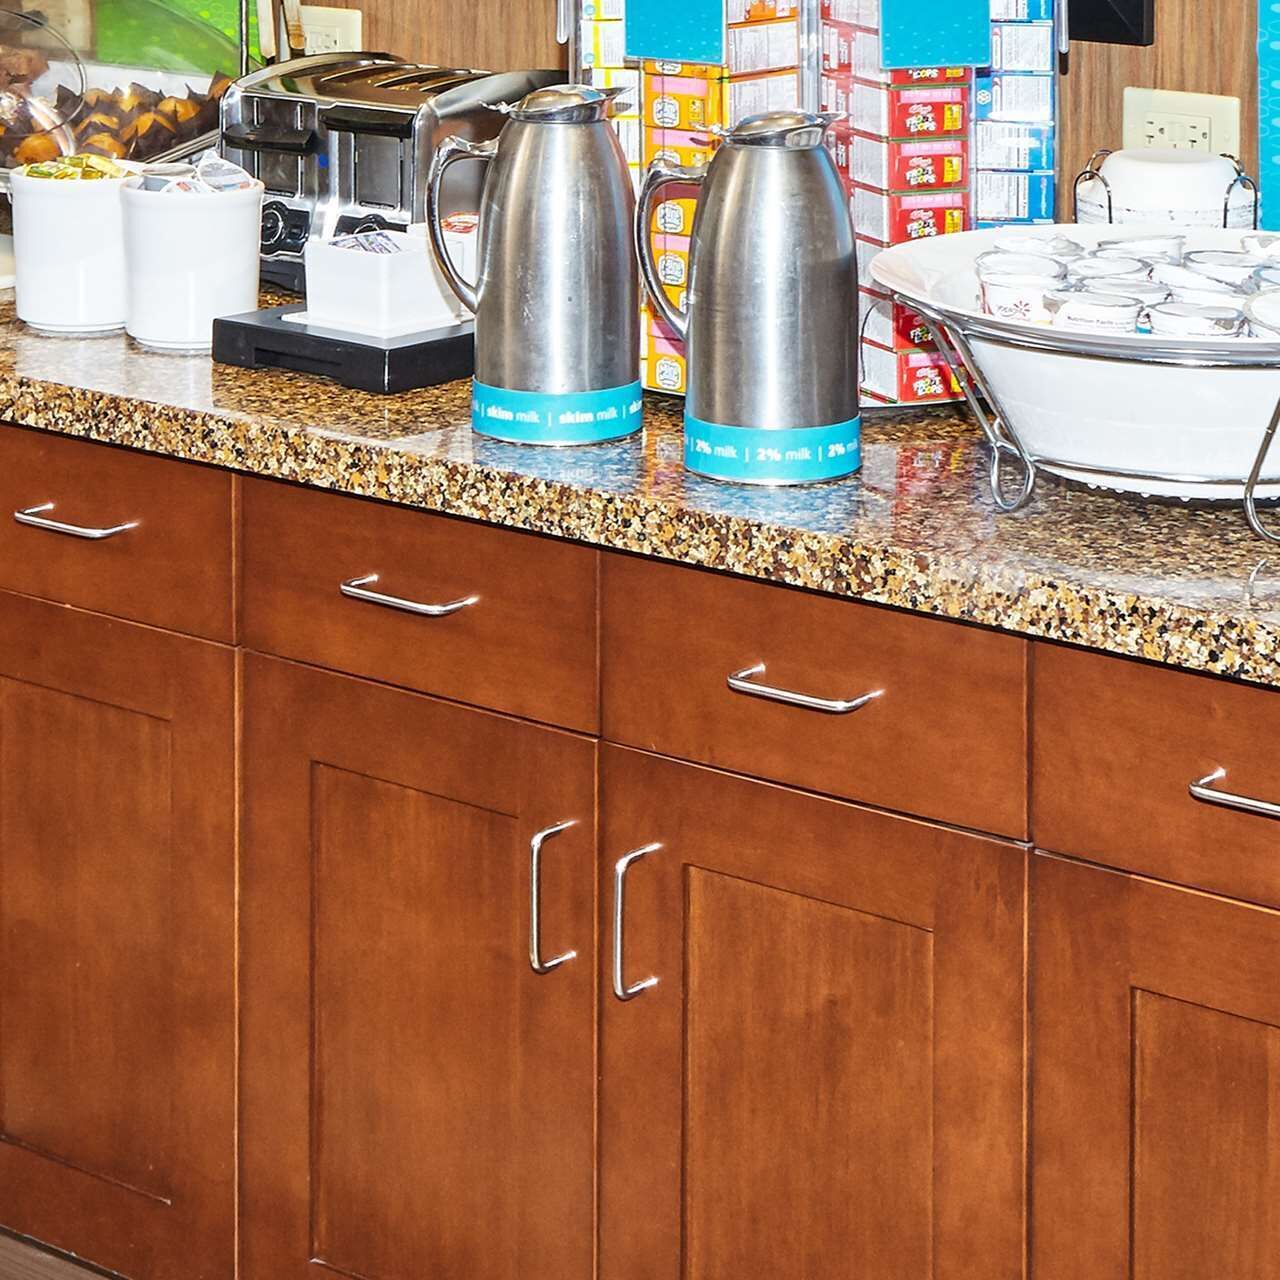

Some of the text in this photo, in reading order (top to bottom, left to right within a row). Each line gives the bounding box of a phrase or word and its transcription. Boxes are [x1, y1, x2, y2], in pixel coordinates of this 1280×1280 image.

[486, 405, 540, 424] skim milk
[559, 406, 618, 424] skim milk
[695, 438, 737, 458] 2% milk
[757, 447, 812, 462] 2% milk
[827, 441, 846, 458] 2%
